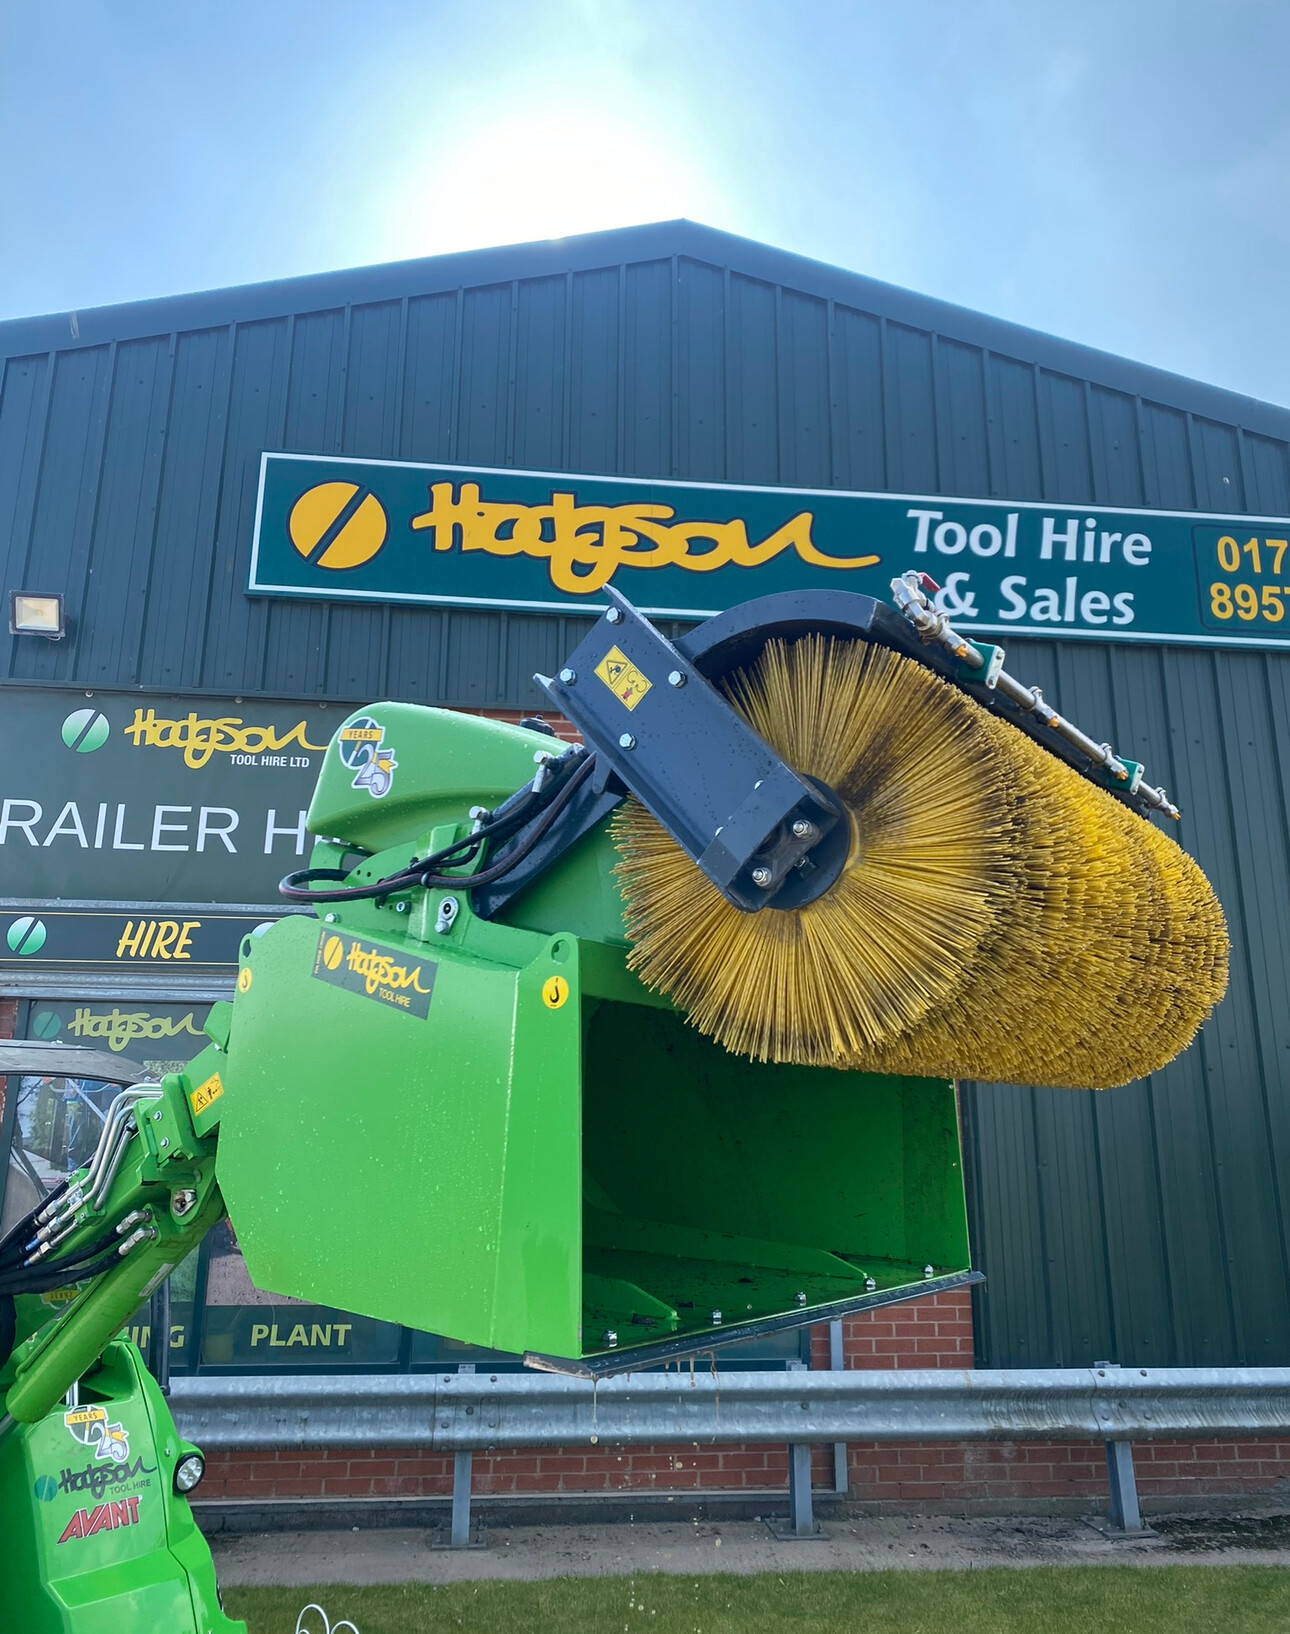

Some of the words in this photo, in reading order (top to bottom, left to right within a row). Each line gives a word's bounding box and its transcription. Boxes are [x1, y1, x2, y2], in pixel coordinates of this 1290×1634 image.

[411, 481, 881, 594] Hodgson
[906, 508, 1019, 557] Tool
[1040, 517, 1152, 565] Hire
[1217, 535, 1288, 574] 017
[935, 571, 979, 618] &
[998, 575, 1135, 625] Sales
[124, 708, 328, 770] Hodgson
[348, 730, 374, 739] YEARS
[230, 754, 259, 766] TOOL
[261, 755, 288, 767] HIRE
[290, 757, 310, 768] LTD
[353, 743, 393, 796] 25
[0, 798, 240, 853] RAILER
[116, 920, 202, 959] HIRE
[346, 941, 431, 994] Hodgson
[379, 987, 396, 1003] TOOL
[395, 993, 411, 1008] HIRE
[67, 1008, 207, 1051] Hodgson
[251, 1324, 352, 1346] PLANT
[73, 1411, 98, 1422] YEARS
[90, 1421, 129, 1461] 25
[58, 1456, 158, 1500] Hodgson
[110, 1484, 131, 1495] TOOL
[133, 1479, 152, 1492] HIRE
[57, 1496, 141, 1545] AVANT
